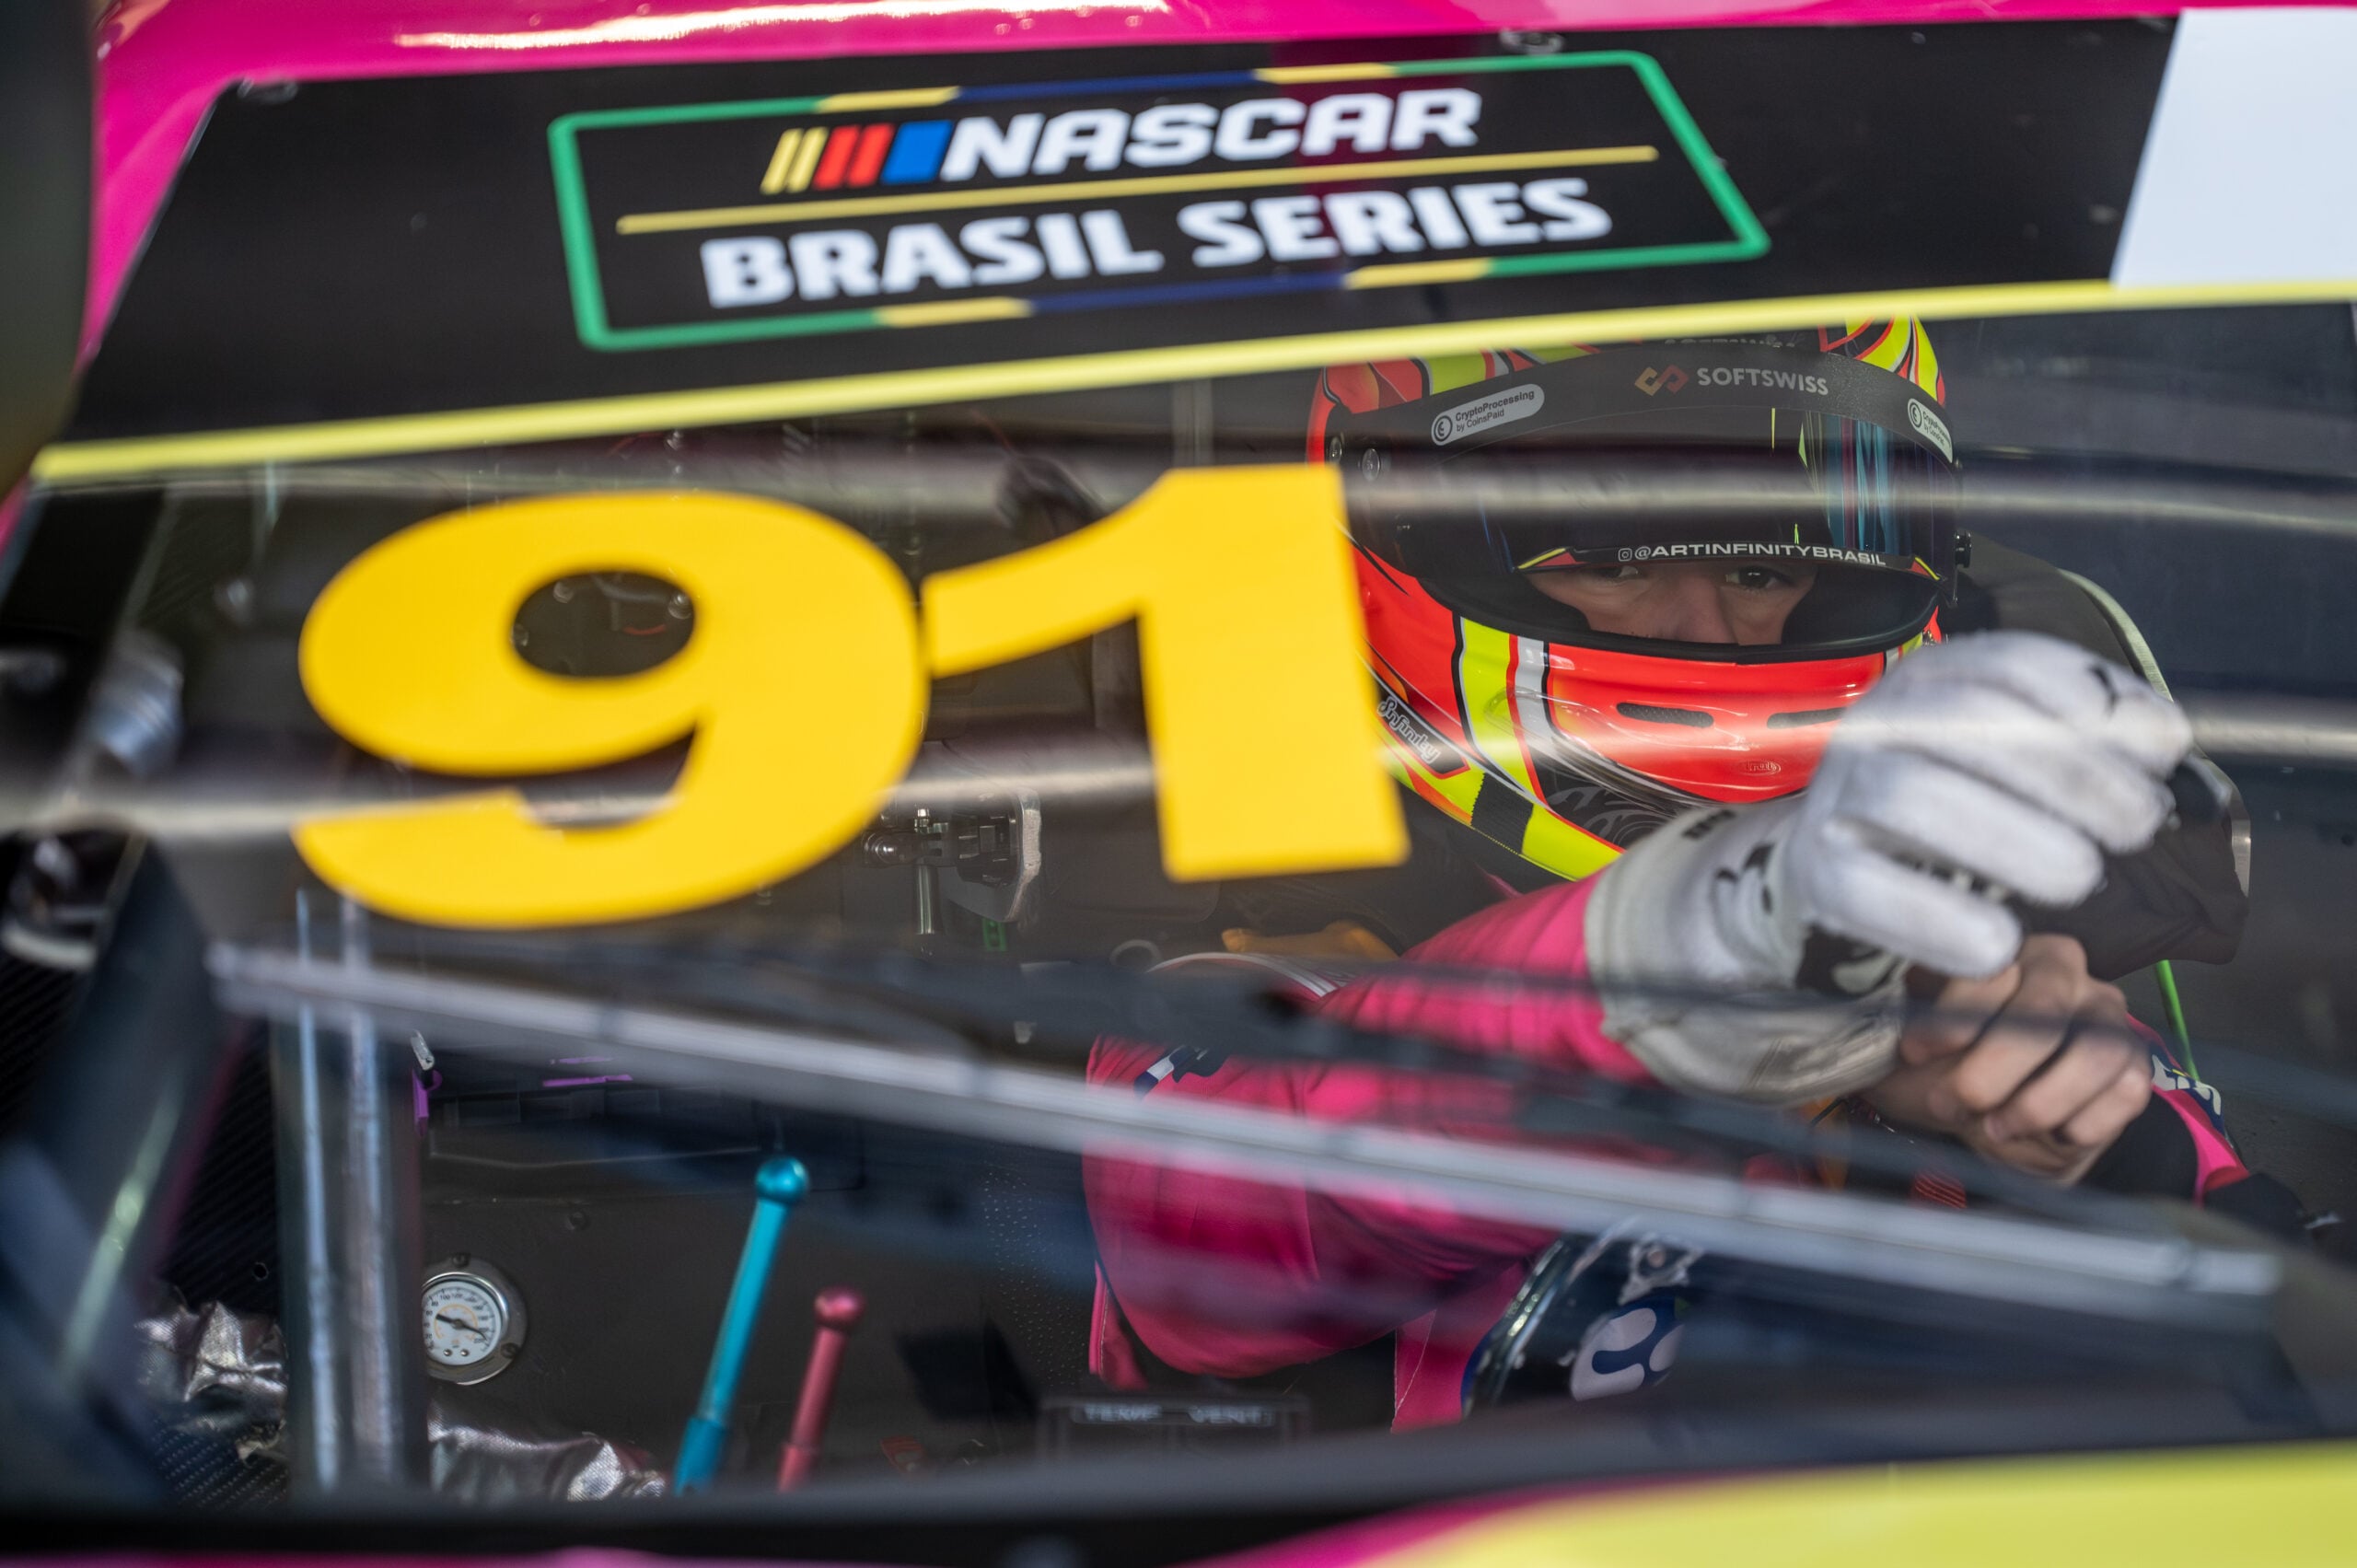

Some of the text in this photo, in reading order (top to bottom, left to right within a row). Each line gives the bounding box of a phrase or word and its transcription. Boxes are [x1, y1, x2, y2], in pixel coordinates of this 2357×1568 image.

[940, 88, 1480, 182] NASCAR
[700, 178, 1613, 308] BRASIL SERIES
[1696, 366, 1829, 396] SOFTSWISS
[1455, 390, 1535, 423] CryptoProcessing
[1456, 409, 1504, 433] by CoinsPaid
[1634, 543, 1887, 566] @ARTINFINITYBRASIL
[292, 465, 1407, 928] 91
